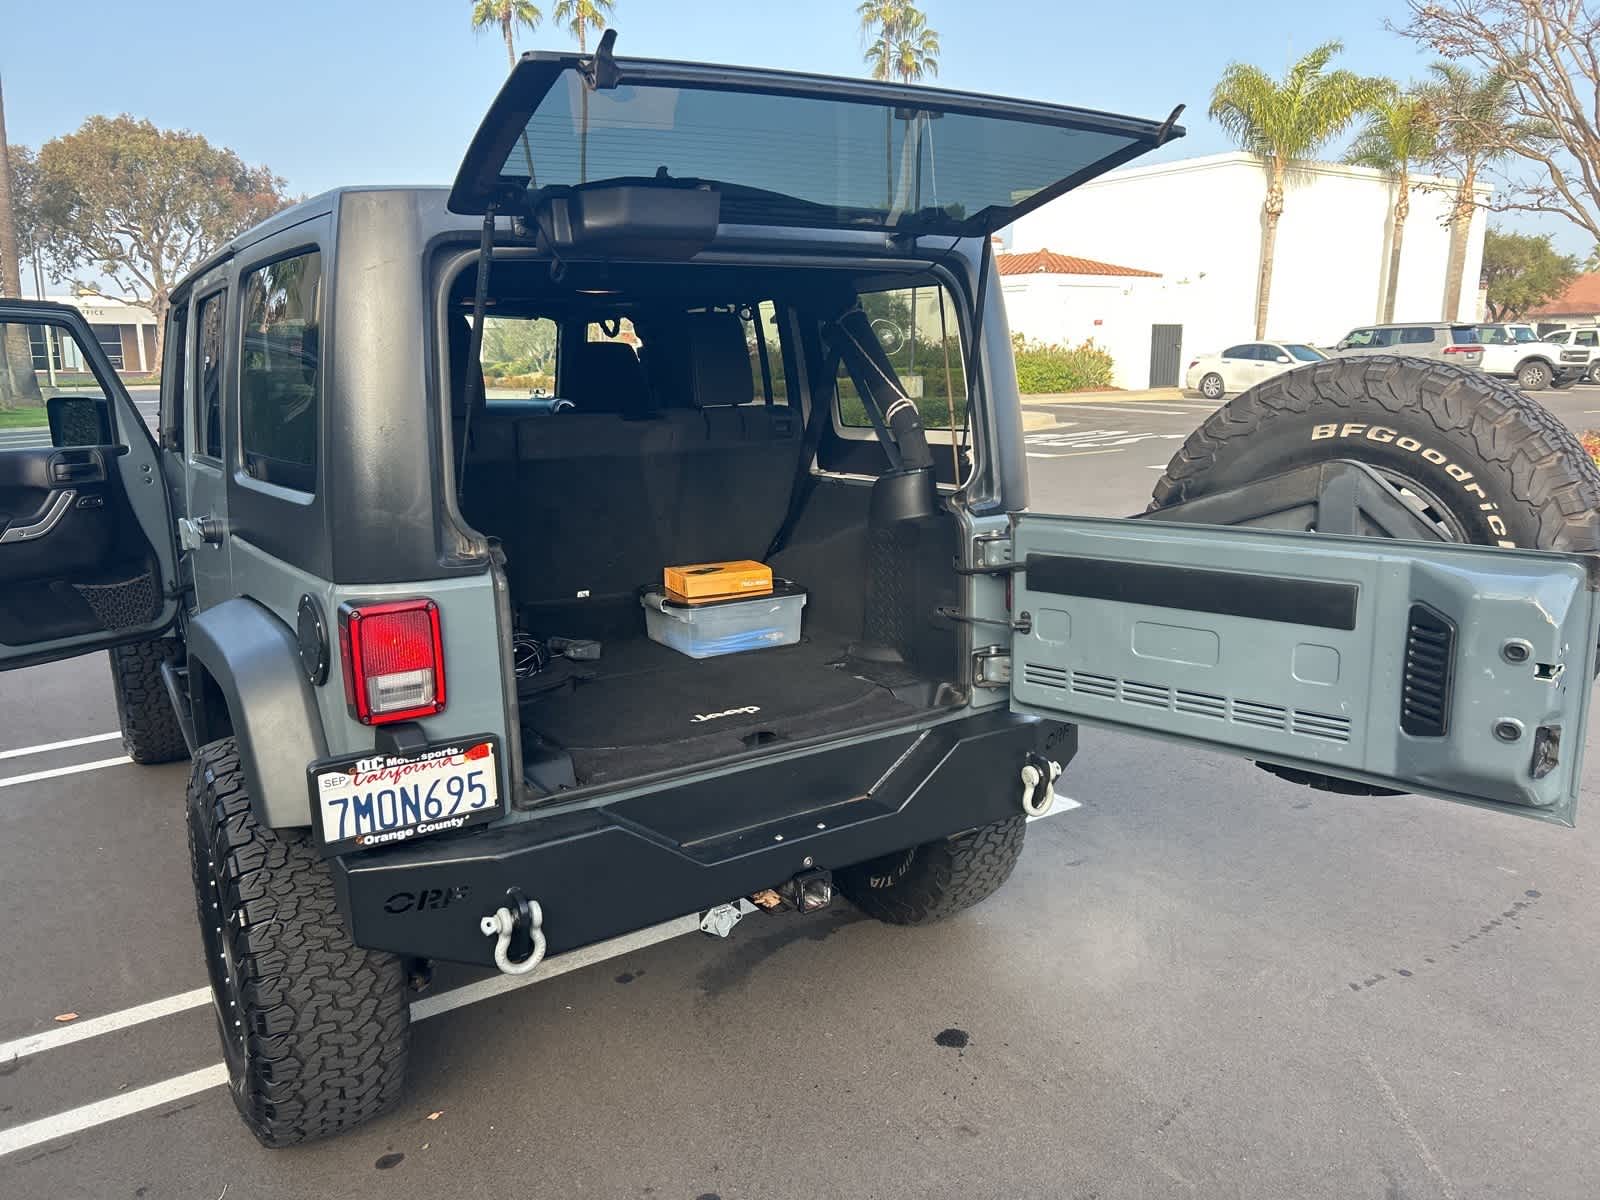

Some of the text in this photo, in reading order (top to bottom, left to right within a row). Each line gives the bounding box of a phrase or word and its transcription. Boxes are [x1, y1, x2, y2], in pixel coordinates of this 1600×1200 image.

[1311, 423, 1516, 549] BFGoodric
[690, 705, 761, 722] Jeep
[323, 776, 346, 788] SEP
[353, 757, 464, 786] California
[328, 770, 487, 840] 7MON695
[364, 817, 464, 845] Orange County
